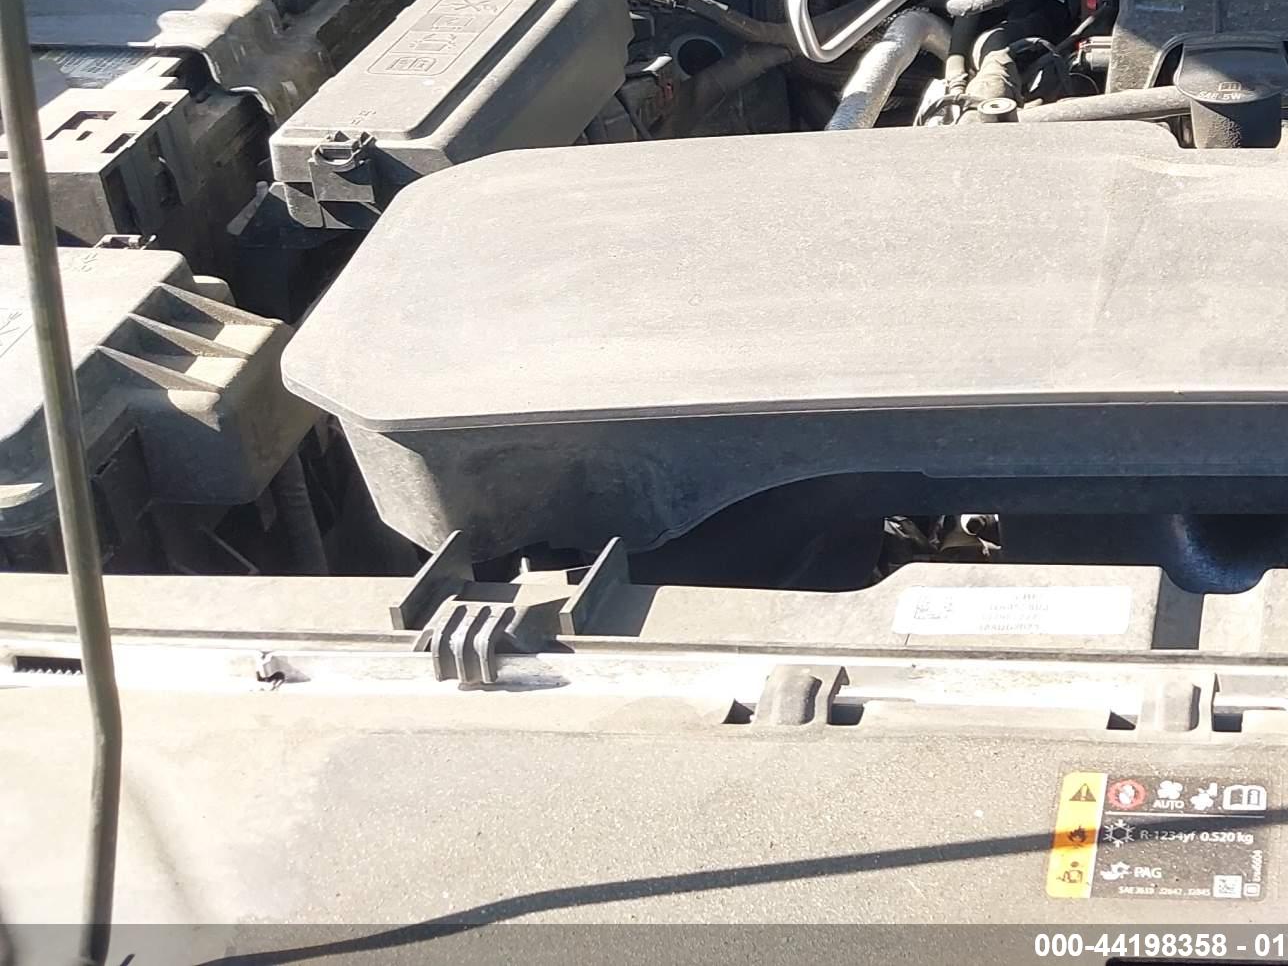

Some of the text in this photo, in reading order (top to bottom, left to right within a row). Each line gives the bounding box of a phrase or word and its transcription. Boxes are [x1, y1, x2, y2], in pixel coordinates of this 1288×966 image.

[1153, 799, 1184, 810] AUTO
[1200, 831, 1235, 842] 0.520
[1237, 831, 1254, 844] kg
[1134, 867, 1162, 878] PAG
